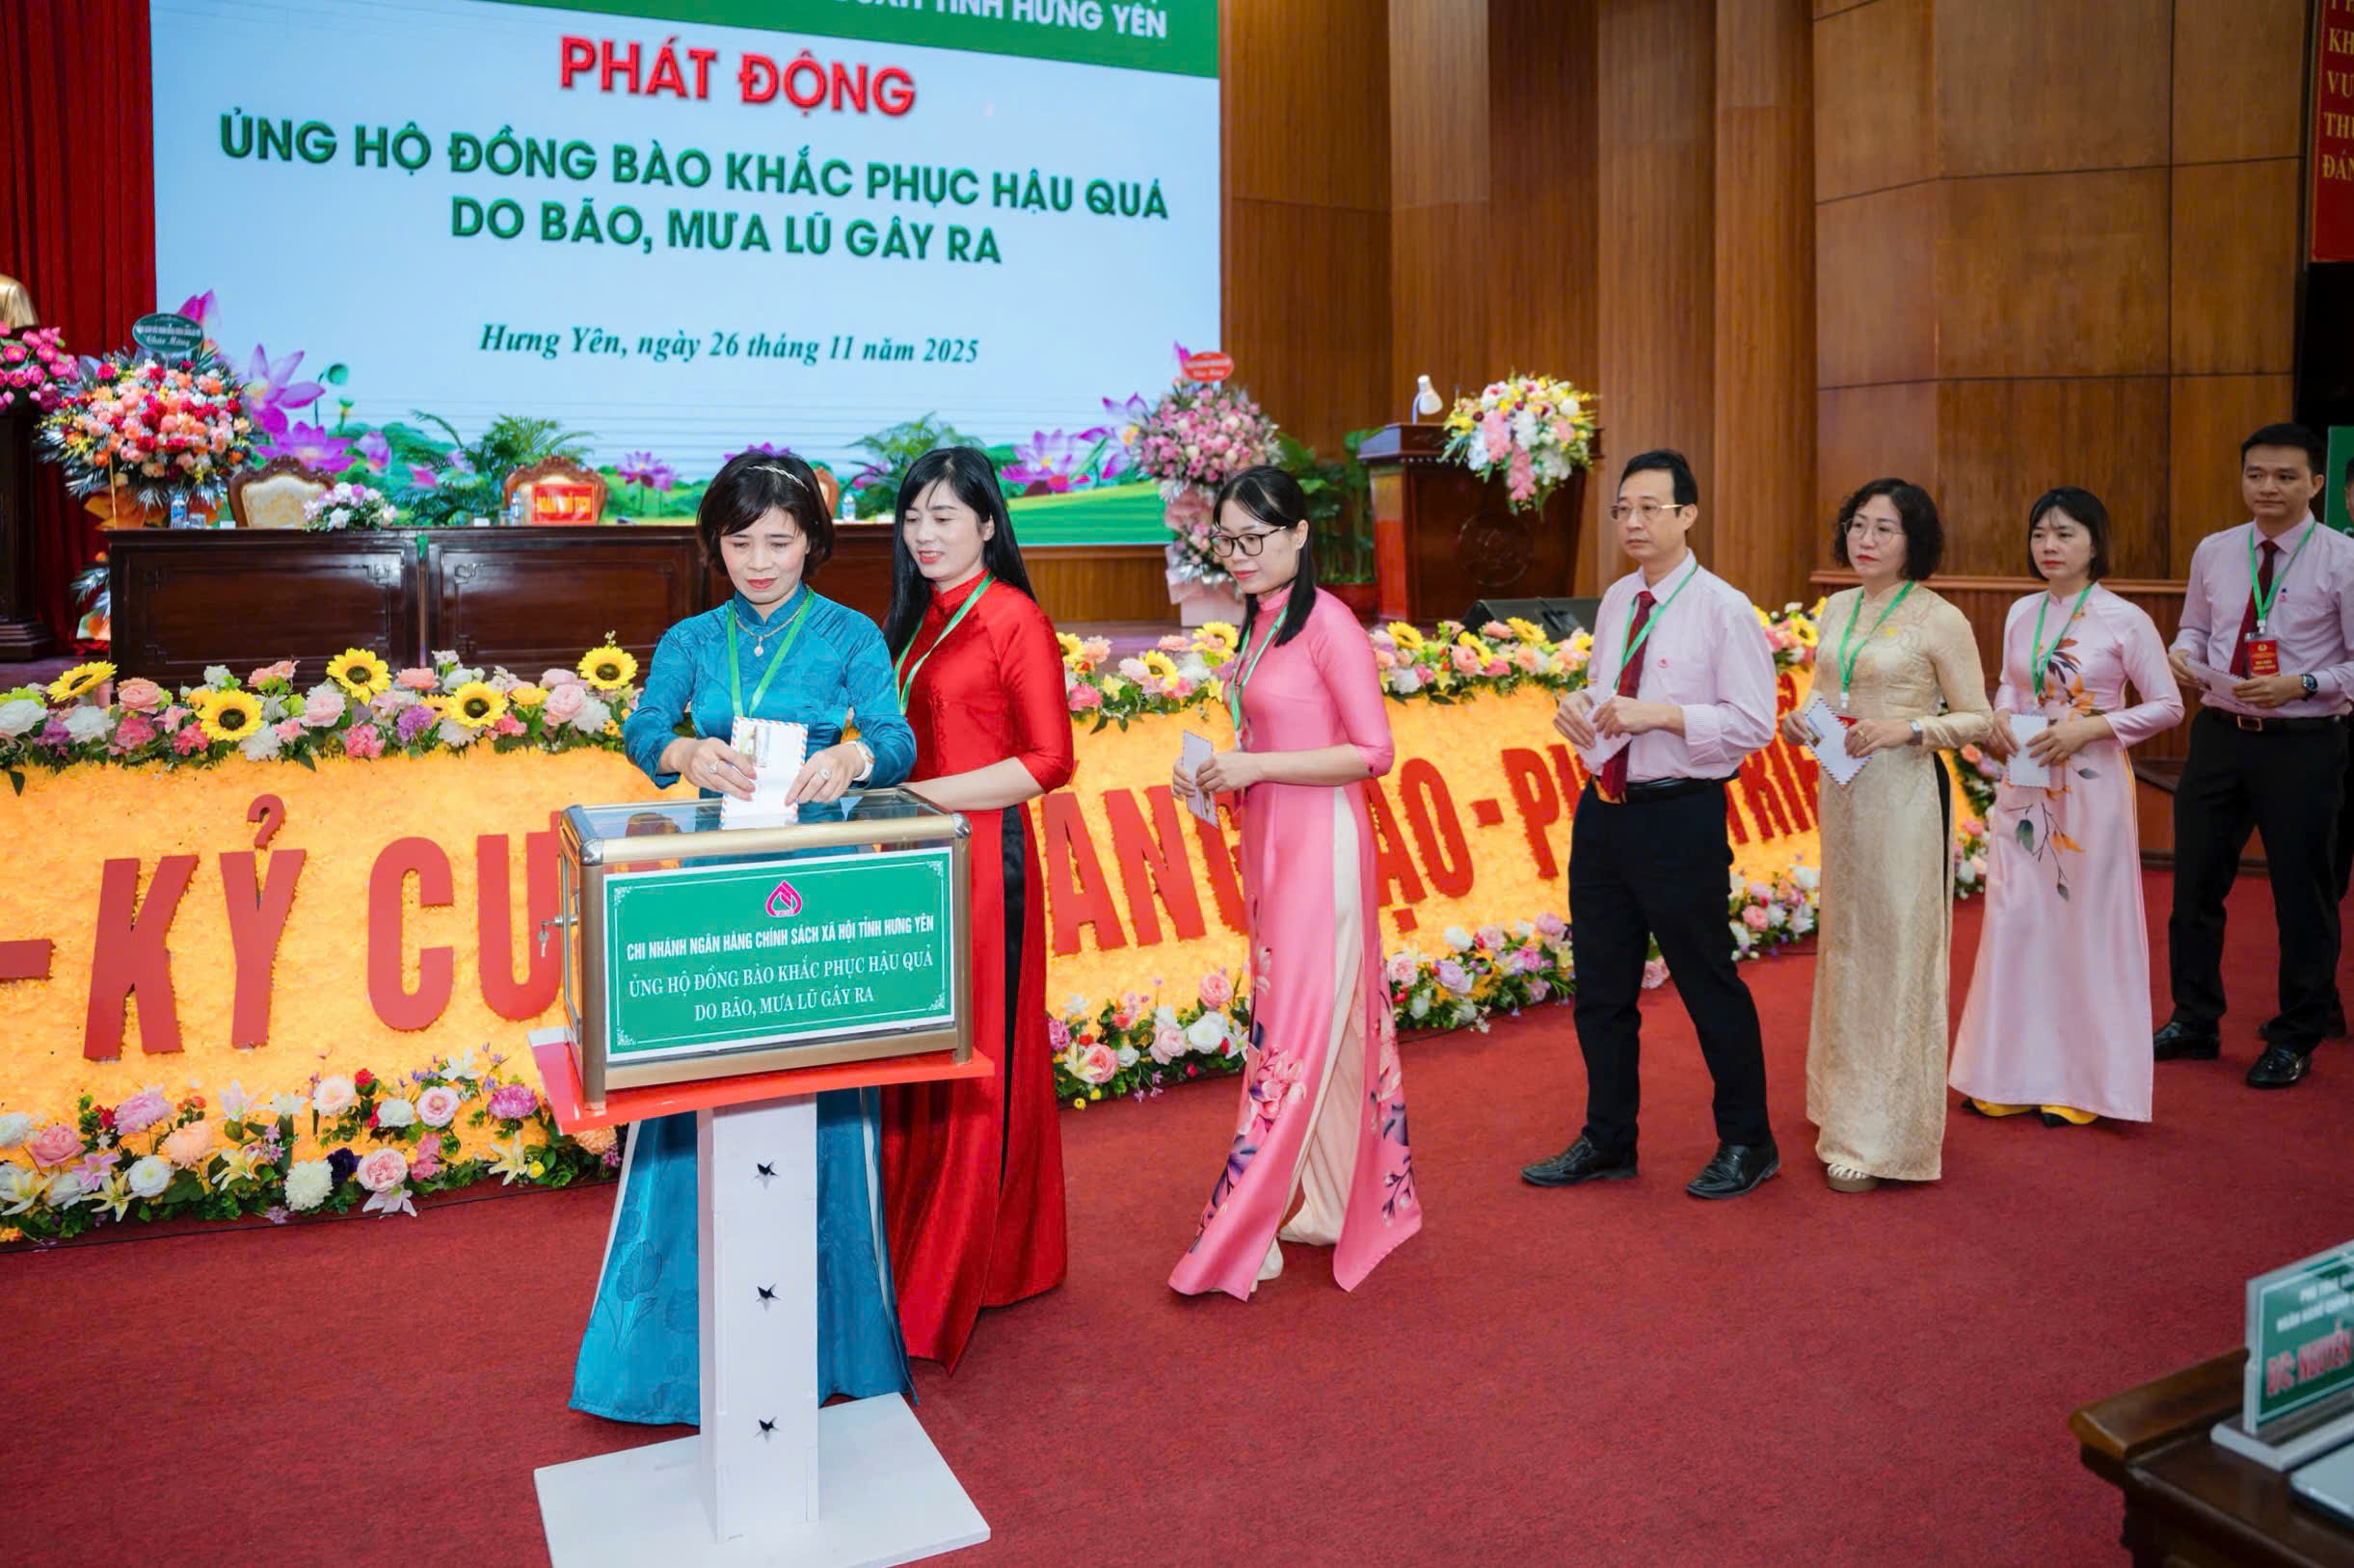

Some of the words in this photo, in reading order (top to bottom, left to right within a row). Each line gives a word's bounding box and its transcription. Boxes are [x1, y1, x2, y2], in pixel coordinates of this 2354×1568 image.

[1110, 2, 1167, 39] YÊN
[560, 35, 717, 100] PHÁT
[738, 47, 916, 117] ĐỘNG
[220, 107, 337, 164] ỦNG
[355, 121, 432, 176] HỘ
[447, 124, 598, 182] ĐỒNG
[612, 138, 711, 189] BÀO
[725, 146, 852, 198] KHẮC
[867, 161, 979, 209] PHỤC
[992, 168, 1073, 215] HẬU
[451, 196, 524, 240] DO
[540, 197, 653, 254] BÃO,
[666, 208, 770, 252] MƯA
[785, 211, 831, 254] LŨ
[845, 217, 933, 260] GÂY
[947, 225, 1002, 264] RA
[479, 323, 562, 360] Hưng
[571, 325, 629, 359] Yên,
[636, 330, 701, 362] ngày
[709, 331, 739, 357] 26
[746, 332, 819, 367] tháng
[829, 334, 854, 360] 11
[863, 337, 915, 361] năm
[923, 337, 979, 363] 2025
[83, 793, 308, 1062] KỶ
[1362, 757, 1475, 933] ẠO
[627, 943, 646, 961] CHI
[649, 936, 687, 959] NHÁNH
[689, 933, 720, 955] NGÂN
[723, 930, 753, 951] HÀNG
[755, 926, 789, 948] CHÍNH
[790, 923, 819, 945] SÁCH
[821, 921, 836, 943] XÃ
[838, 918, 855, 943] HỘI
[858, 916, 882, 939] TỈNH
[884, 916, 912, 936] HƯNG
[914, 912, 934, 933] YÊN
[629, 973, 663, 998] ỦNG
[667, 970, 691, 997] HỘ
[693, 965, 739, 992] ĐỒNG
[742, 964, 774, 987] BÀO
[778, 954, 820, 983] KHẮC
[823, 956, 865, 979] PHỤC
[869, 949, 899, 975] HẬU
[902, 943, 934, 971] QUẢ
[694, 1002, 717, 1022] DO
[721, 997, 757, 1020] BÃO,
[760, 993, 794, 1015] MƯA
[797, 988, 817, 1010] LŨ
[820, 984, 851, 1007] GÂY
[854, 986, 874, 1003] RA
